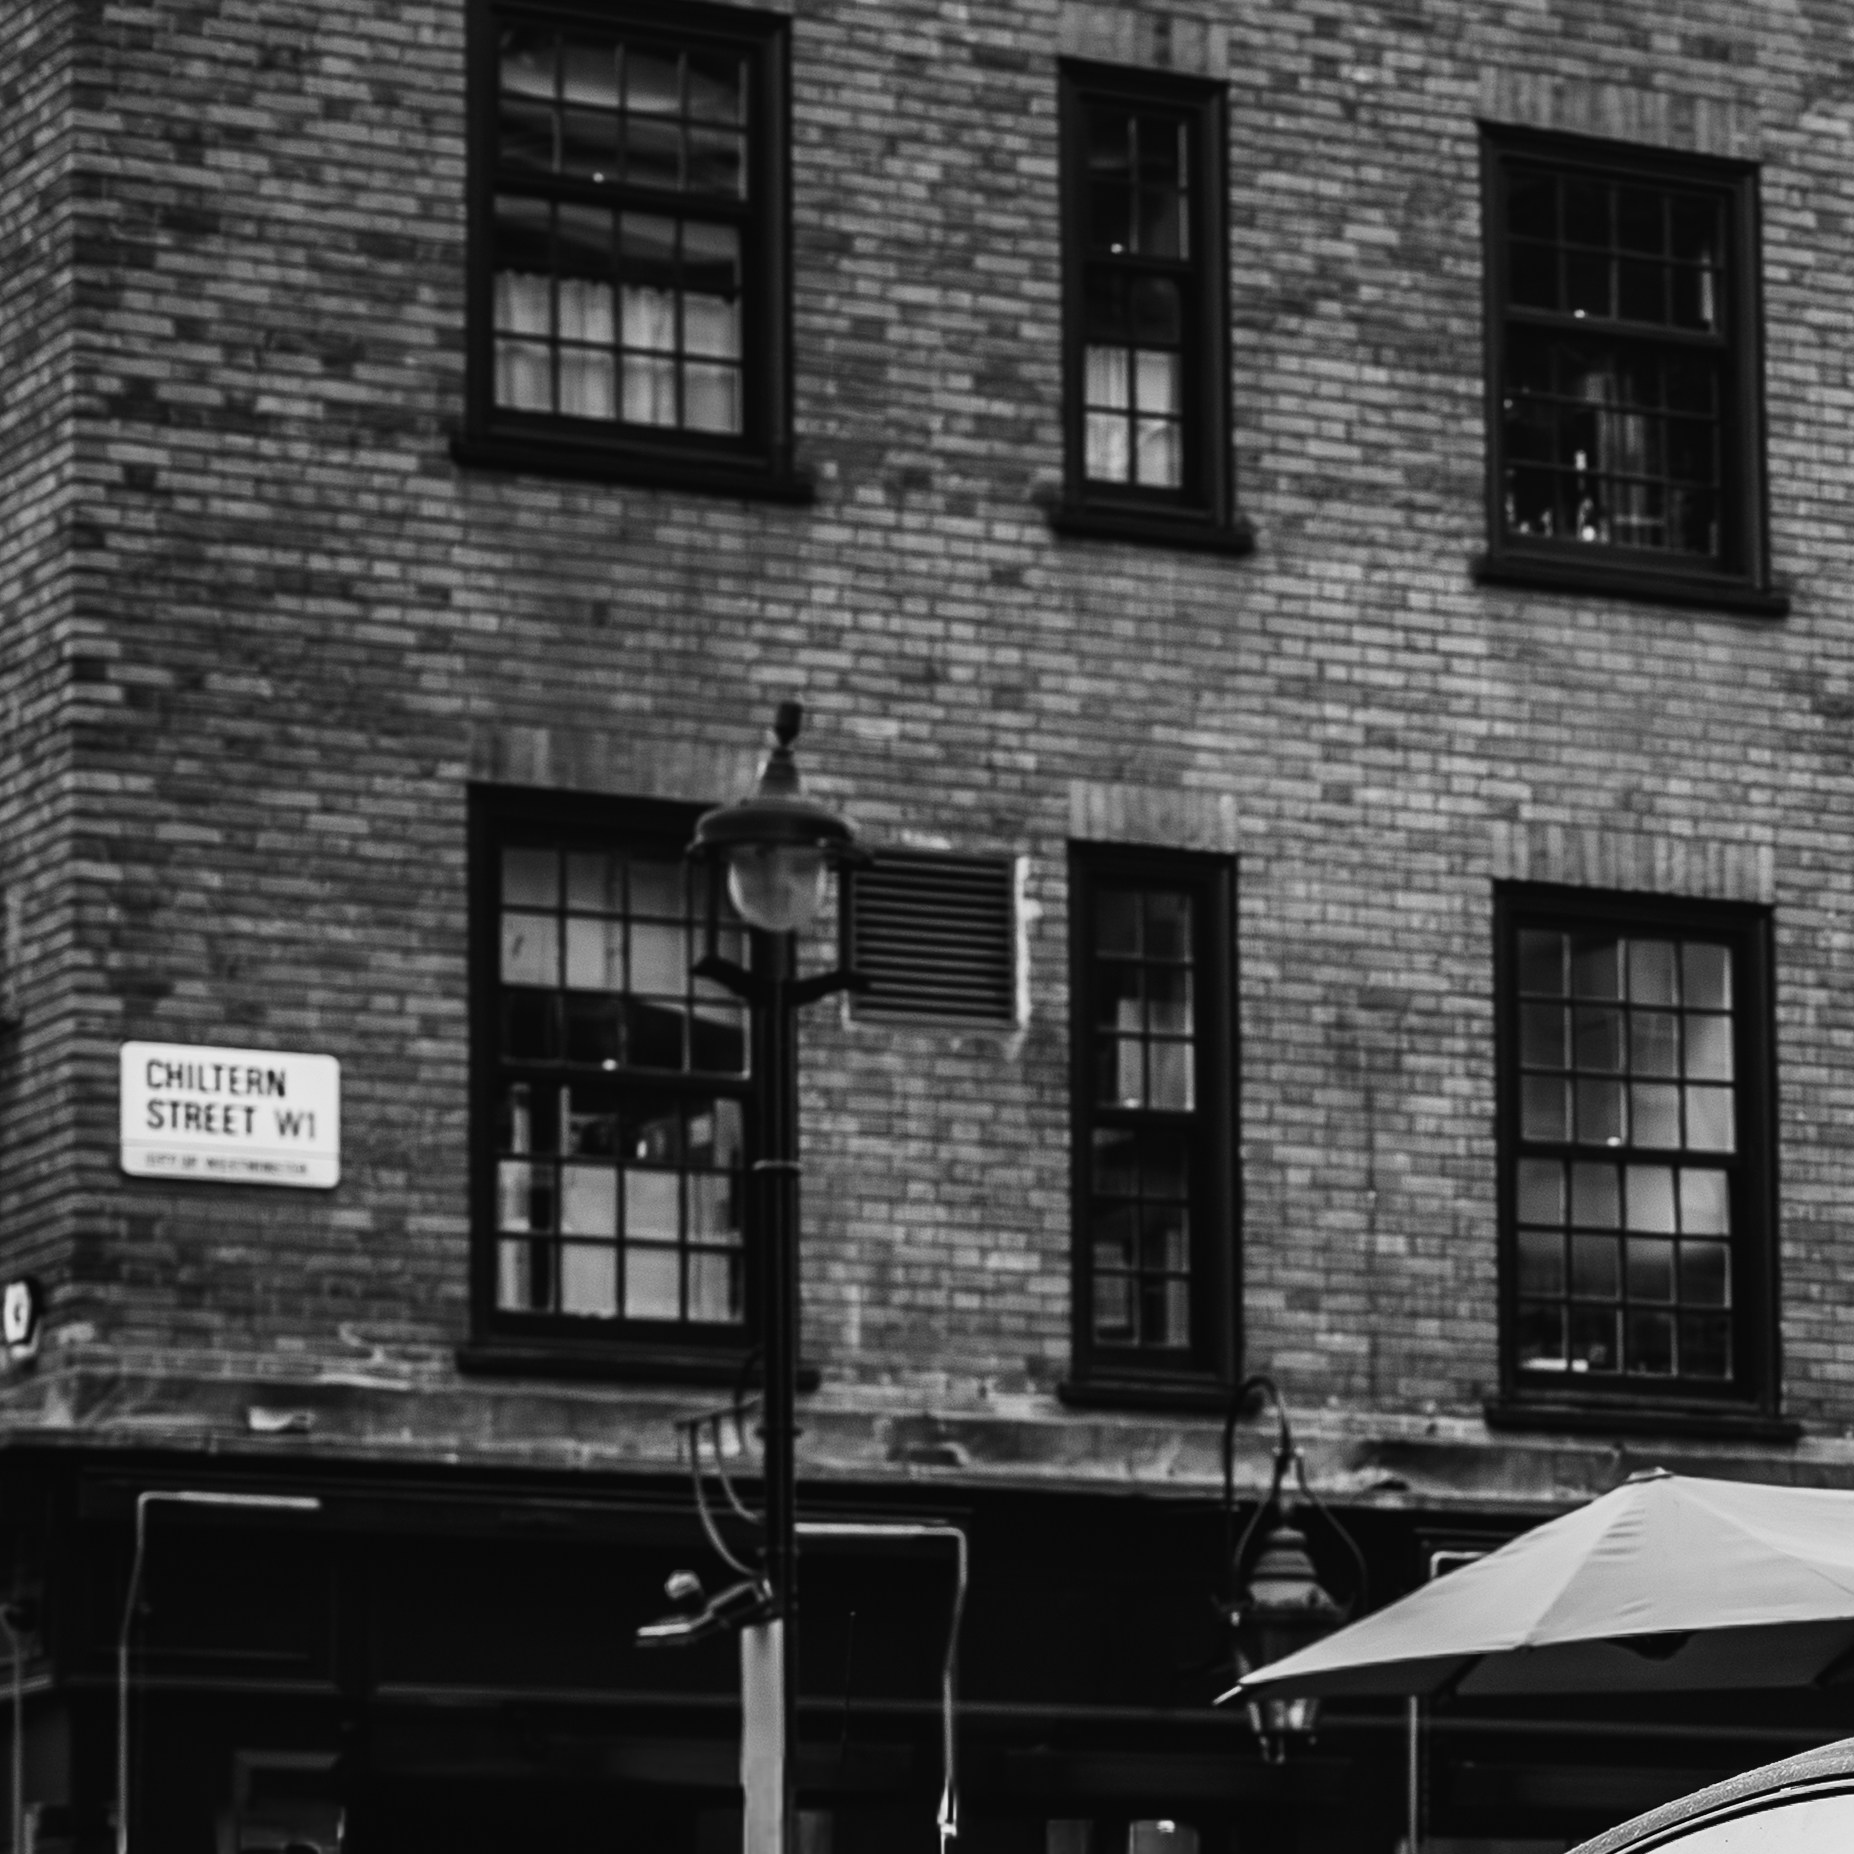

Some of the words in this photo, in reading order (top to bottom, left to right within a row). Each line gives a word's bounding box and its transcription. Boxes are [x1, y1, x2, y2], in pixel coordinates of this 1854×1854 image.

[146, 1058, 287, 1098] CHILTERN
[146, 1098, 257, 1136] STREET
[274, 1108, 317, 1141] W1
